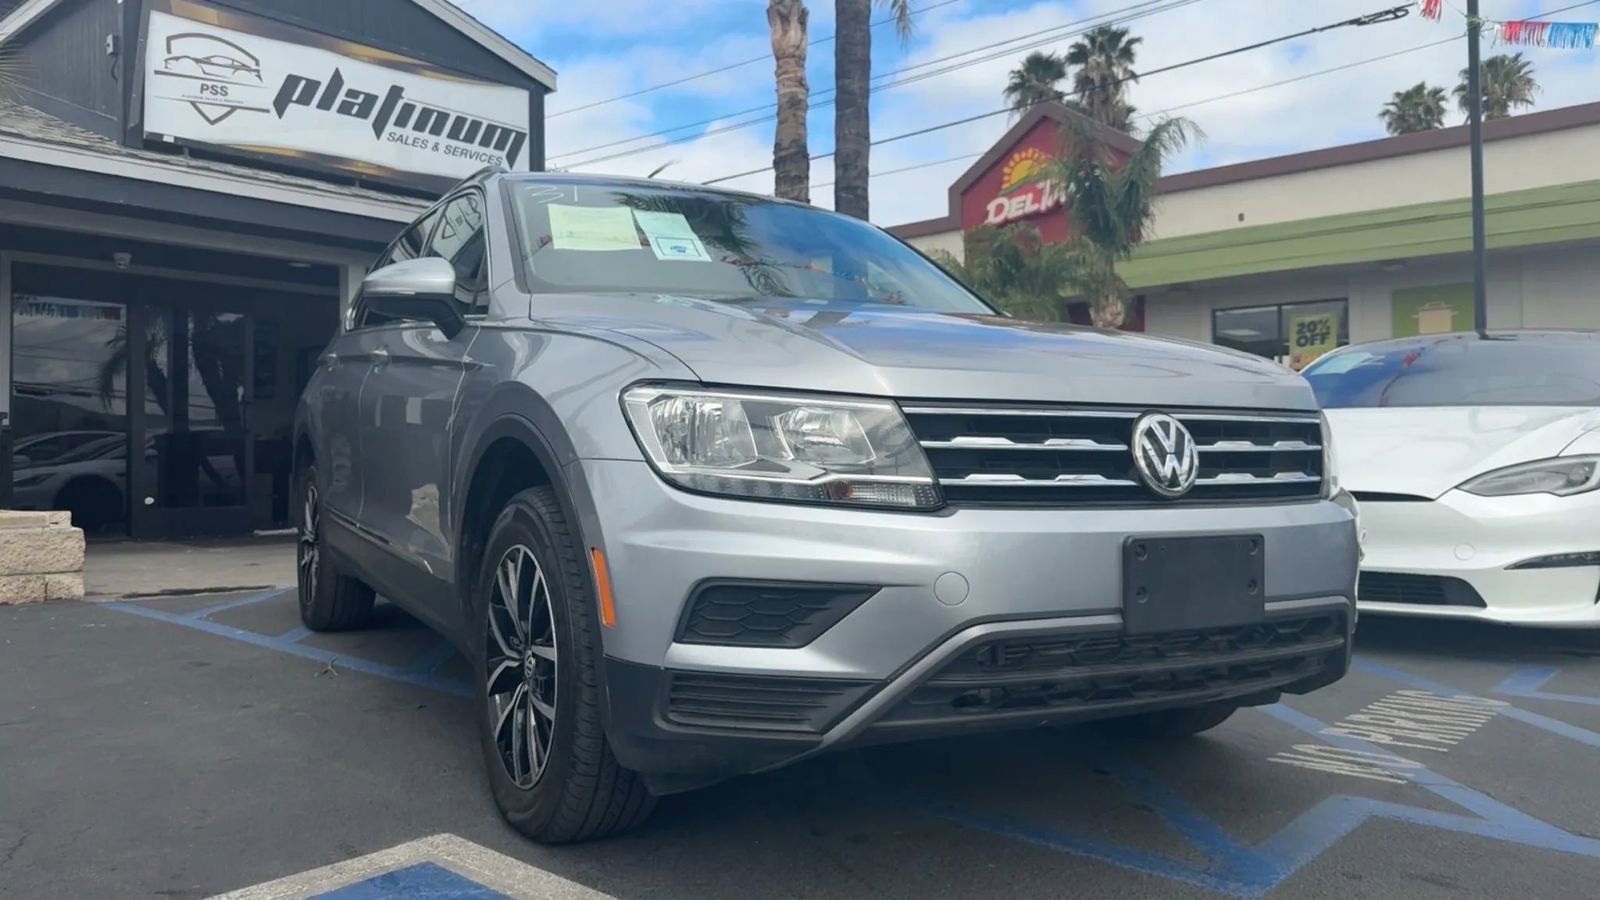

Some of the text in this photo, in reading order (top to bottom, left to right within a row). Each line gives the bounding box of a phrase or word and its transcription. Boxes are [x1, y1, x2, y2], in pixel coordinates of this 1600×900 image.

[200, 83, 229, 97] PSS
[273, 67, 529, 170] platinum
[386, 131, 504, 167] SALES & SERVICES
[984, 193, 1040, 224] DEL
[1296, 319, 1330, 336] 20%
[1296, 334, 1329, 348] OFF
